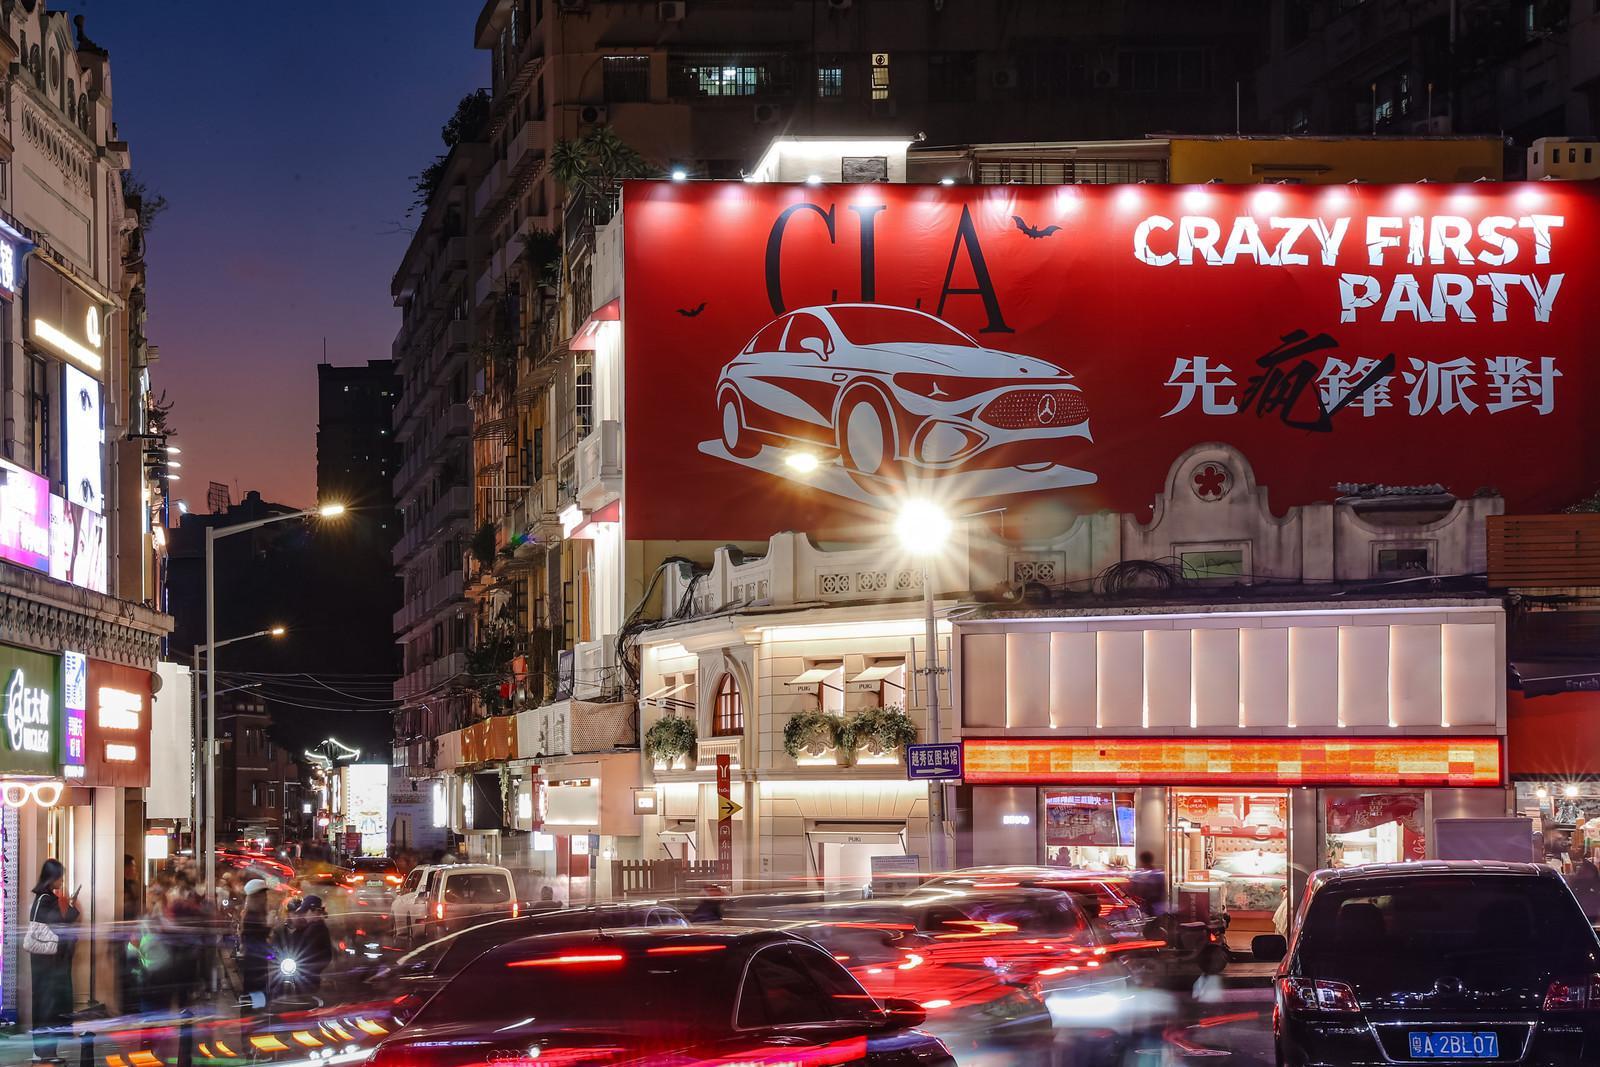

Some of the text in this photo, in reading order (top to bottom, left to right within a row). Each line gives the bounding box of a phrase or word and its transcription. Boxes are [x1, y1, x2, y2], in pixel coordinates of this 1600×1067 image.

[1133, 214, 1565, 267] CRAZY FIRST
[1338, 272, 1565, 323] PARTY
[911, 748, 958, 767] 越秀区图书馆
